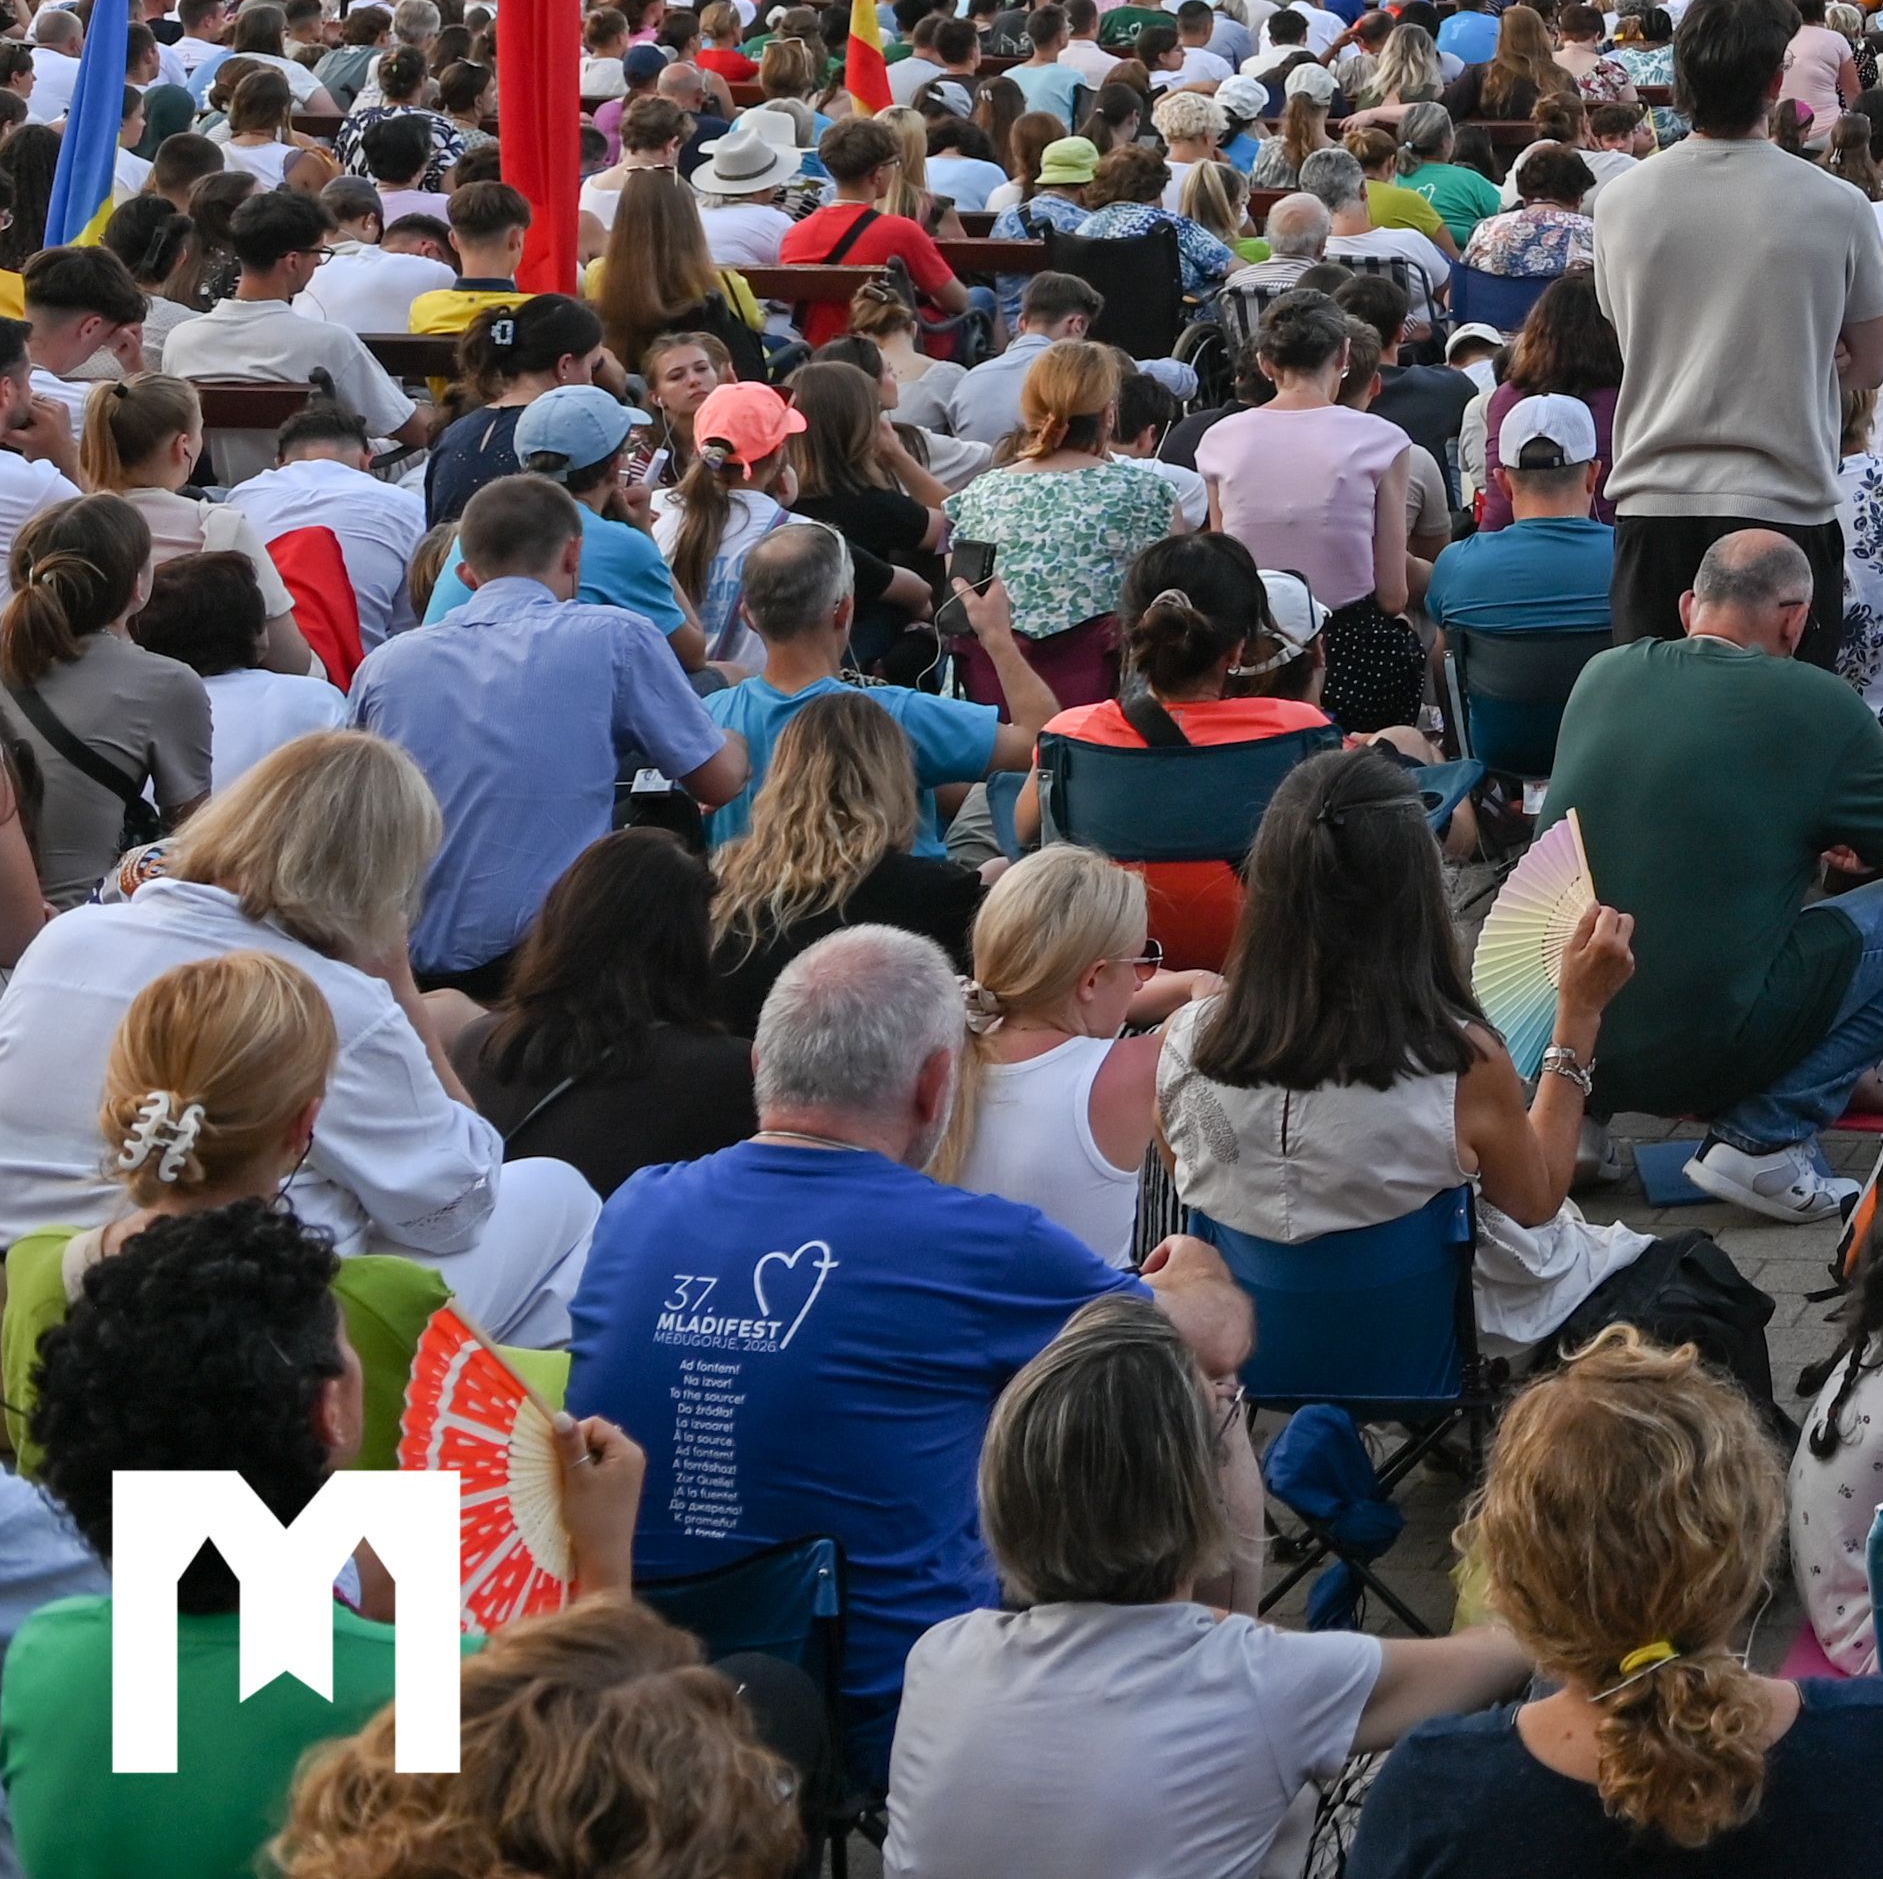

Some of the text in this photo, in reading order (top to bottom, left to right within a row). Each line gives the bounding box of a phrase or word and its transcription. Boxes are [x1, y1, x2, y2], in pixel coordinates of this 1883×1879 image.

[656, 1312, 783, 1340] MLADIFEST
[670, 1387, 681, 1399] To
[683, 1389, 701, 1401] the
[678, 1403, 692, 1414] Do
